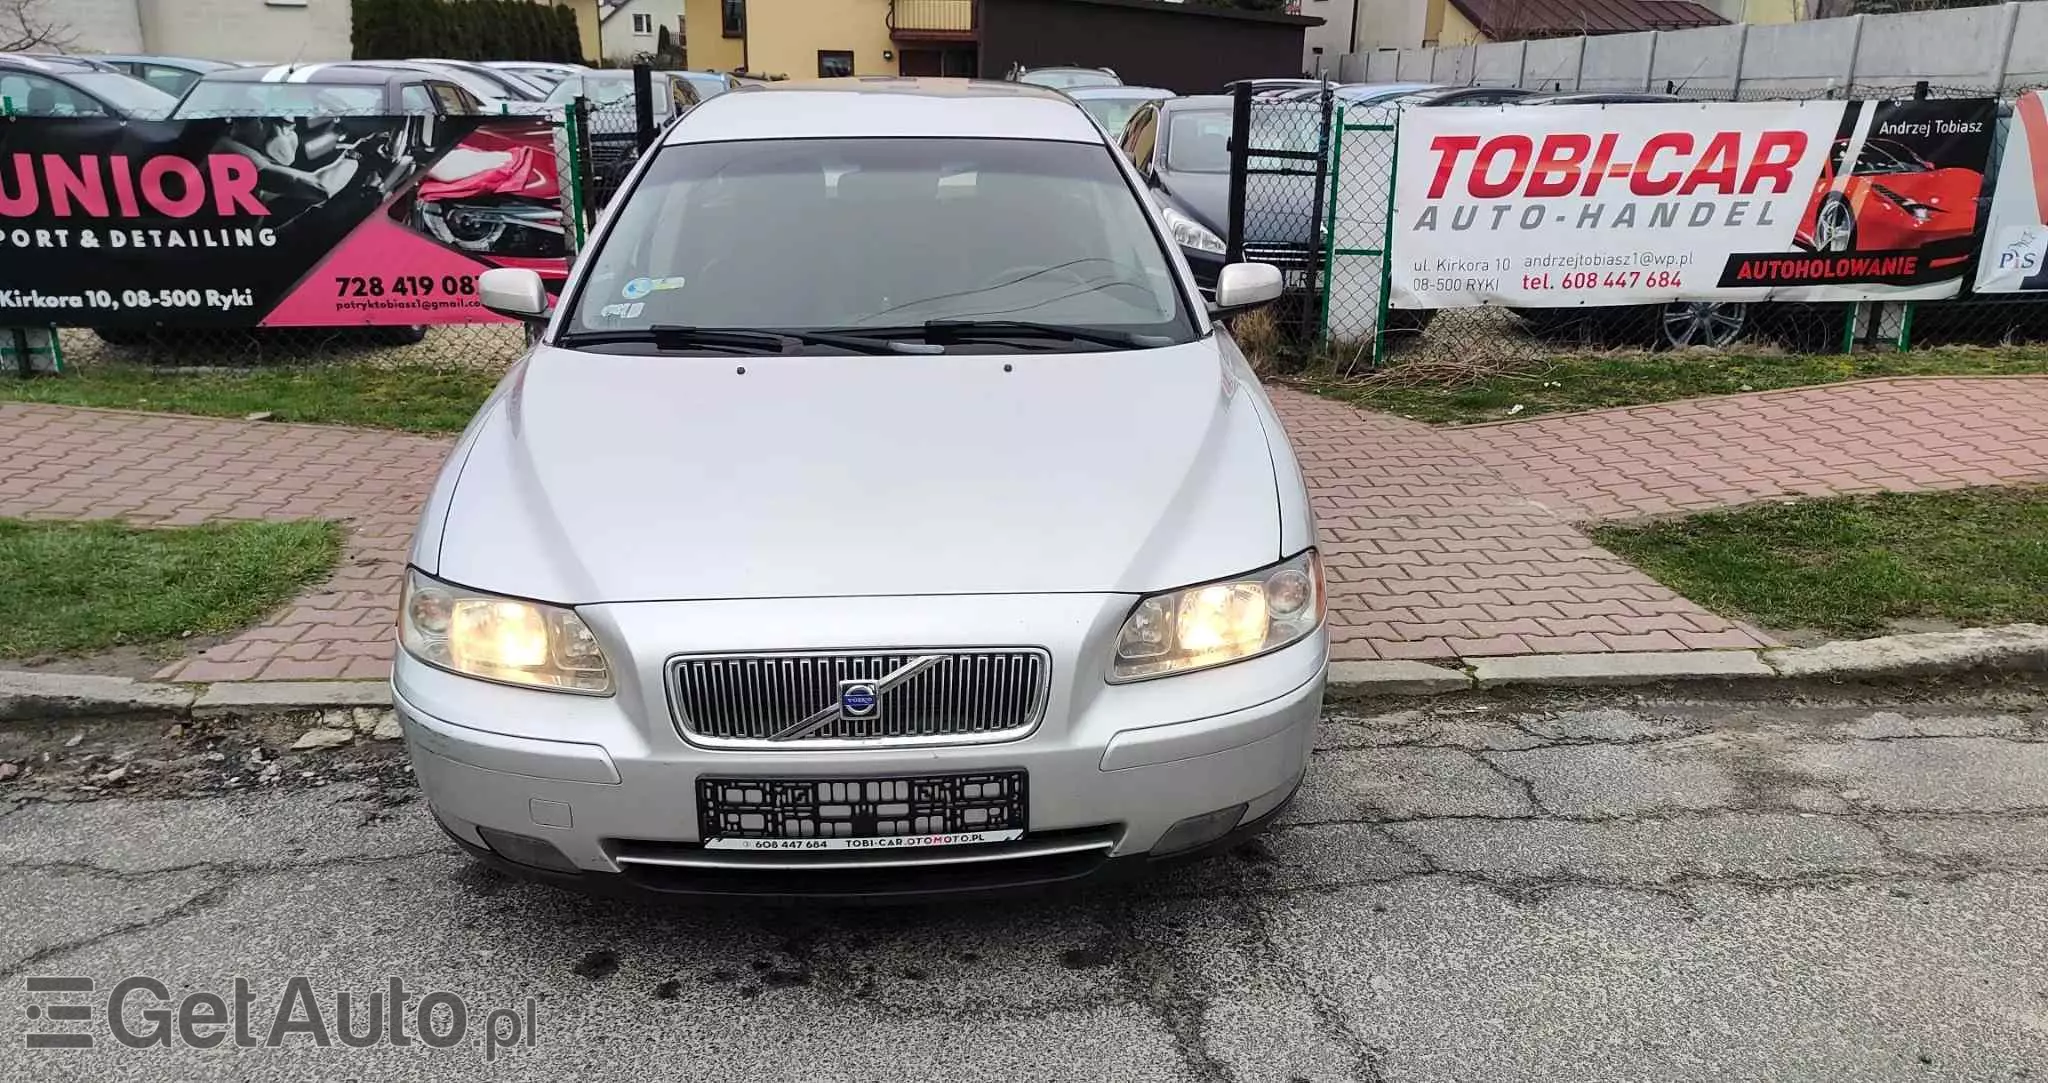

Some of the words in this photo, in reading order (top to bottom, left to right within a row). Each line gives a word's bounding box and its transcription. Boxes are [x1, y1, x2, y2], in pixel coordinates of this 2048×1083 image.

[1879, 119, 1931, 137] Andrzej
[1935, 119, 1983, 134] Tobiasz
[1426, 131, 1808, 199] TOBI-CAR
[0, 153, 272, 218] UNIOR
[1413, 200, 1775, 231] AUTO-HANDEL
[80, 229, 100, 248] &
[110, 228, 277, 248] DETAILING
[1414, 260, 1431, 272] ul.
[1437, 258, 1489, 272] Kirkora
[1496, 258, 1511, 271] 10
[1524, 251, 1693, 269] andrzejtobiasz1@wp.pl
[1736, 256, 1919, 280] AUTOHOLOWANIE
[336, 276, 385, 297] 728
[392, 275, 434, 296] 419
[1413, 278, 1462, 292] 08-500
[1466, 278, 1500, 291] RYKI
[1522, 273, 1554, 290] tel.
[1561, 272, 1598, 290] 608
[1603, 270, 1641, 289] 447
[1646, 270, 1682, 288] 684
[0, 289, 84, 308] Kirkora
[85, 290, 119, 310] 10,
[122, 290, 201, 307] 08-500
[206, 288, 254, 310] Ryki
[336, 298, 481, 312] patryktobiasz1@gmail.co
[755, 840, 779, 849] 608
[781, 840, 803, 849] 447
[806, 840, 828, 849] 684
